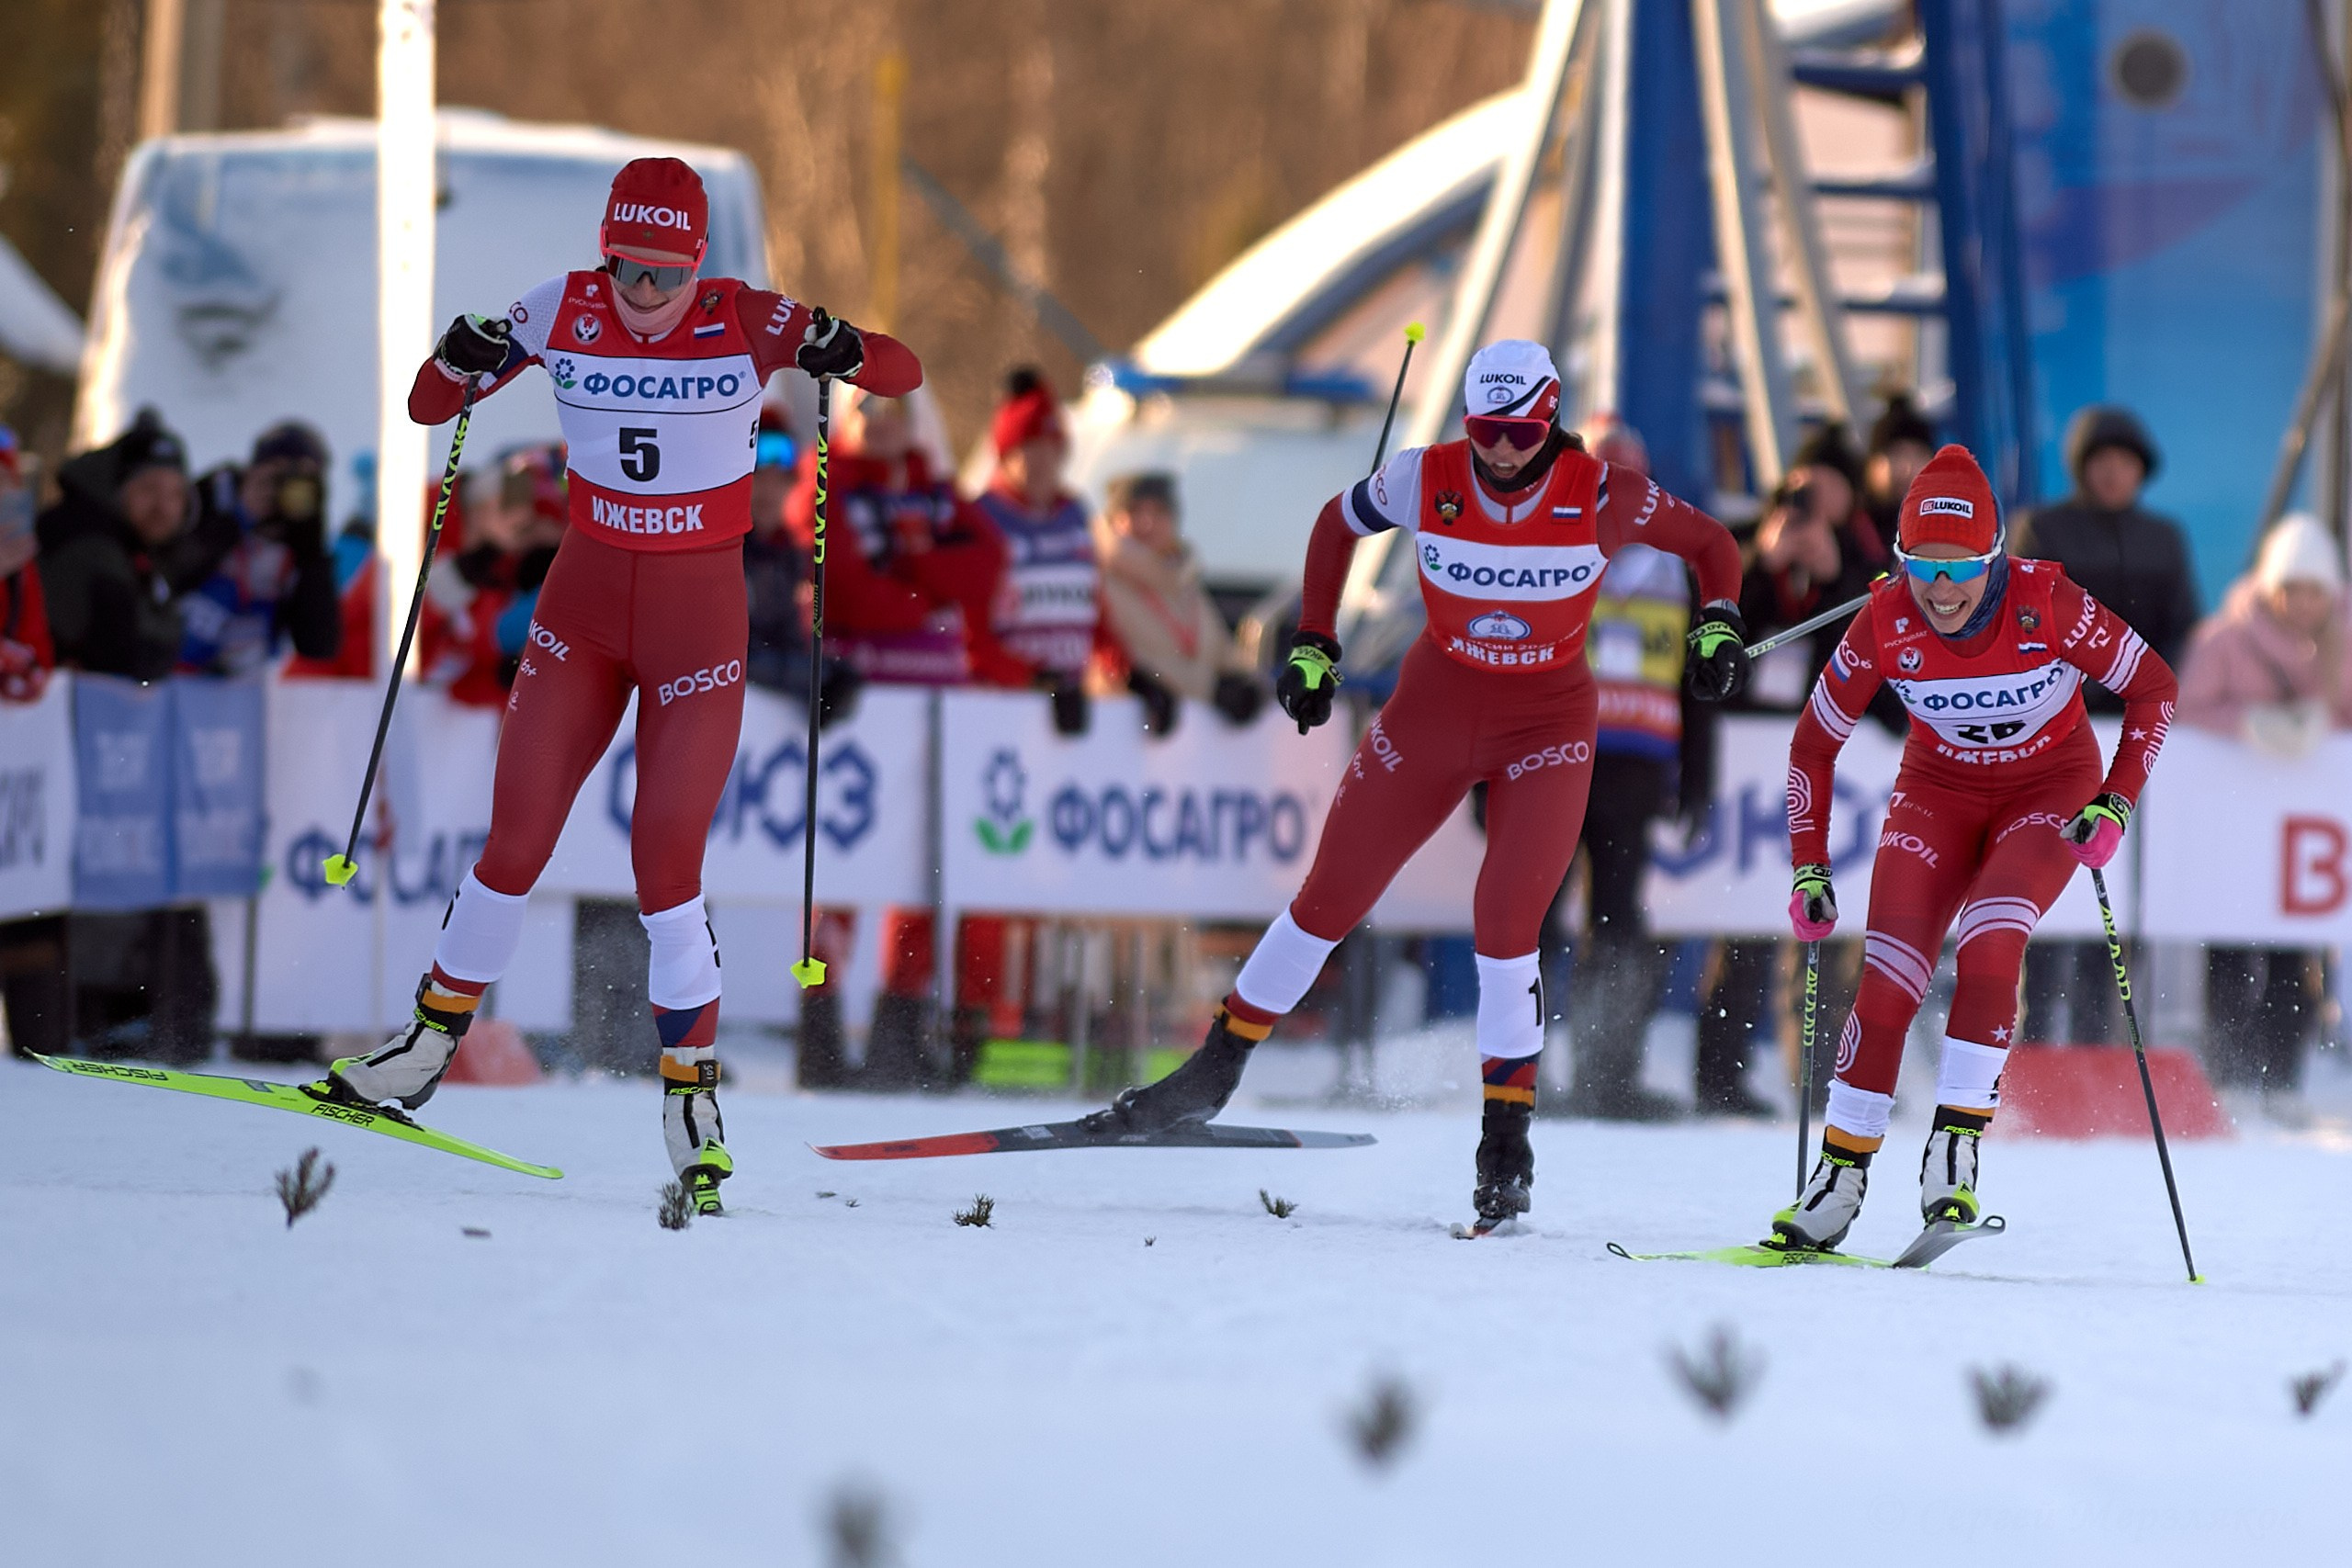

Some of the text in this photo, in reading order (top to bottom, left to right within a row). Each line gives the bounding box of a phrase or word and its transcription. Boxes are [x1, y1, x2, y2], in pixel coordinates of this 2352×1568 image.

[613, 202, 692, 231] LUKOIL
[1479, 373, 1527, 386] LUKOIL
[619, 426, 661, 482] 5
[592, 494, 705, 535] ИЖЕВСК
[1934, 501, 1972, 513] LUKOIL
[658, 659, 741, 707] BOSCO
[1923, 666, 2064, 711] ФОСАГРО
[1506, 739, 1590, 782] BOSCO
[1048, 781, 1307, 864] ФОСАГРО
[72, 1060, 169, 1082] FISCHER
[311, 1102, 376, 1128] FISCHER
[1781, 1252, 1820, 1265] FISCHER
